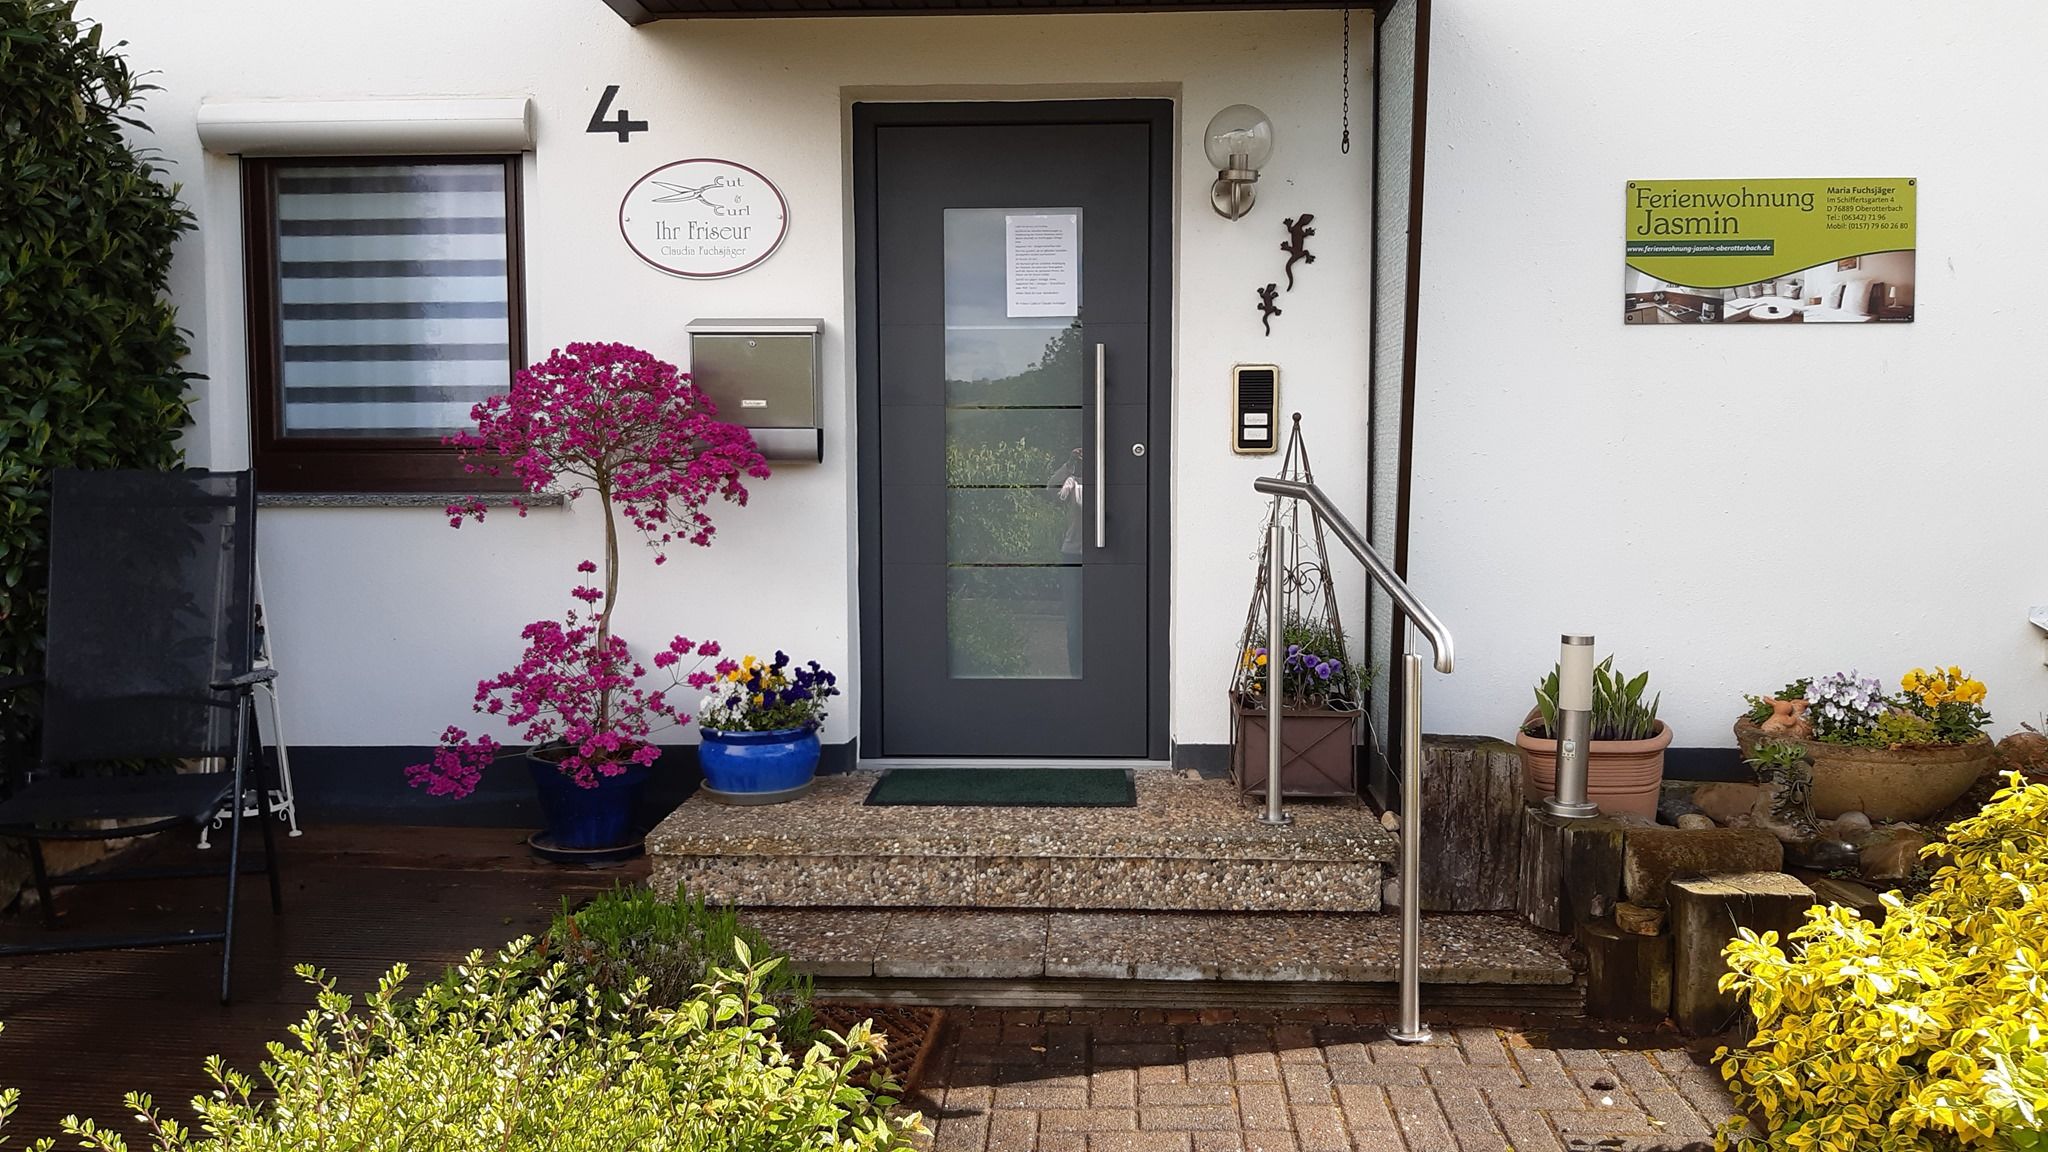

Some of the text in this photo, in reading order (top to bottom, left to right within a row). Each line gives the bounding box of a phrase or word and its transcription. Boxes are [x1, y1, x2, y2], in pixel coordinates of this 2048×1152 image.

[585, 85, 649, 143] 4
[713, 175, 745, 188] Cut
[1826, 186, 1896, 196] Maria Fuchsjäger
[1635, 187, 1815, 211] Ferienwohnung
[1836, 196, 1888, 205] Schiffertsgarten
[713, 205, 751, 216] Curl
[1636, 210, 1740, 236] Jasmin
[1841, 213, 1867, 222] (06342)
[655, 219, 751, 240] Ihr Friseur
[1826, 222, 1847, 230] Mobil:
[1848, 222, 1870, 230] (0157)
[660, 245, 747, 259] Claudia Fuchsjäger
[1626, 244, 1771, 254] www.ferienwohnung-jasmin-oberotterbach.de
